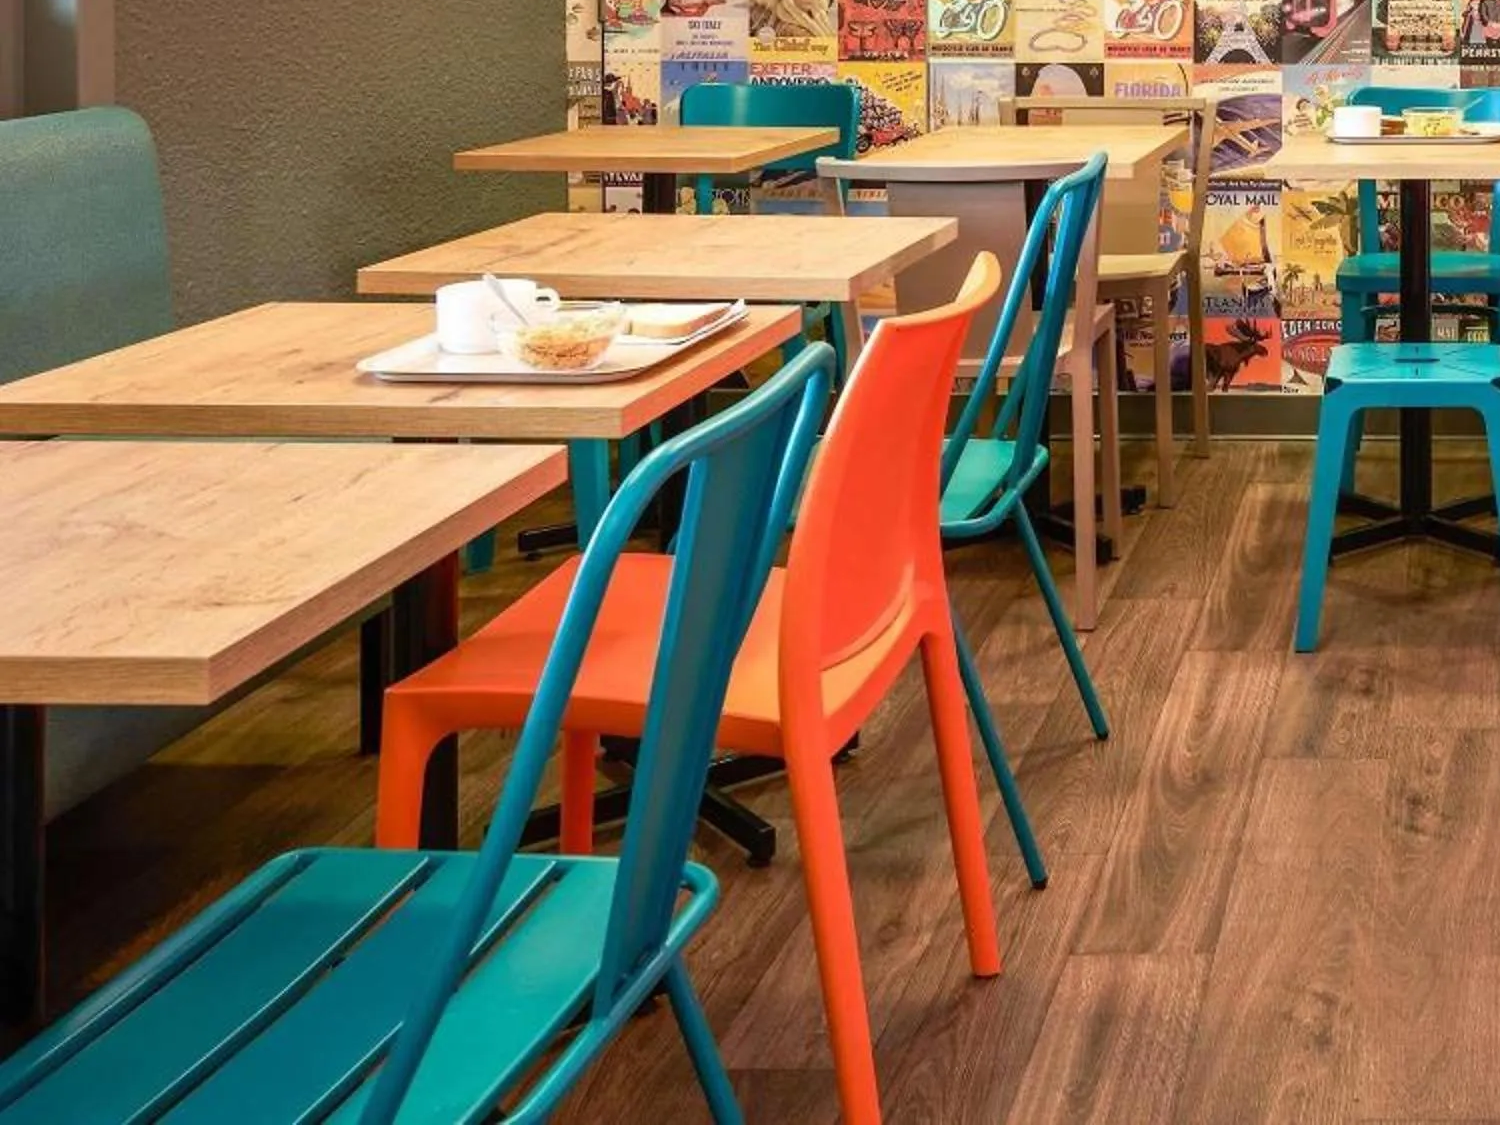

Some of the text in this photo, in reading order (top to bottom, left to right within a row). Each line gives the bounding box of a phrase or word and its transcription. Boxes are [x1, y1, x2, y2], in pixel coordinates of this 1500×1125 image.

[751, 63, 810, 75] EXETER
[1114, 82, 1181, 98] FLORIDA
[1205, 193, 1279, 206] OYAL MAIL
